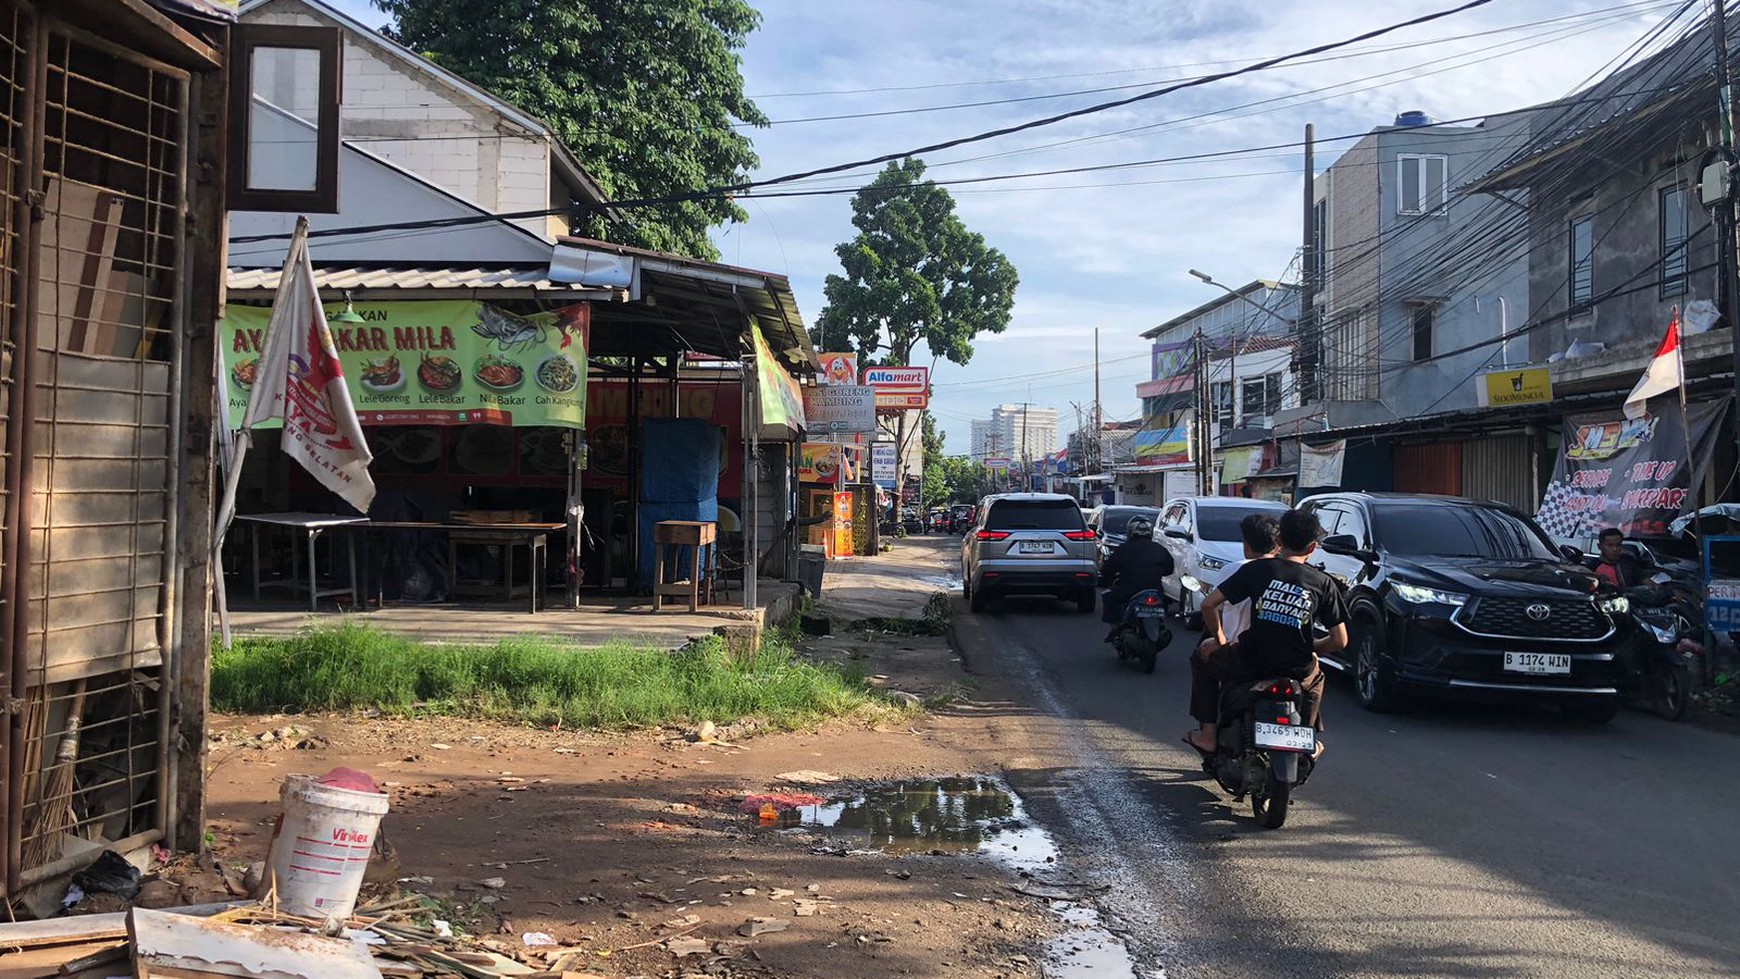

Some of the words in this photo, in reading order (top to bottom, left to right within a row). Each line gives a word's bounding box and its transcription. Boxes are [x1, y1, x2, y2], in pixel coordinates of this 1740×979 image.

[393, 326, 456, 351] MILA
[869, 372, 922, 382] Alfamart
[829, 387, 870, 397] GORENG
[229, 398, 247, 409] Aya
[304, 444, 353, 483] SELATAN
[1656, 460, 1677, 482] UP
[1268, 579, 1312, 599] MALES
[1262, 589, 1312, 610] KELUAR
[1506, 654, 1512, 664] B
[1548, 656, 1568, 668] WIN
[1256, 723, 1262, 733] B
